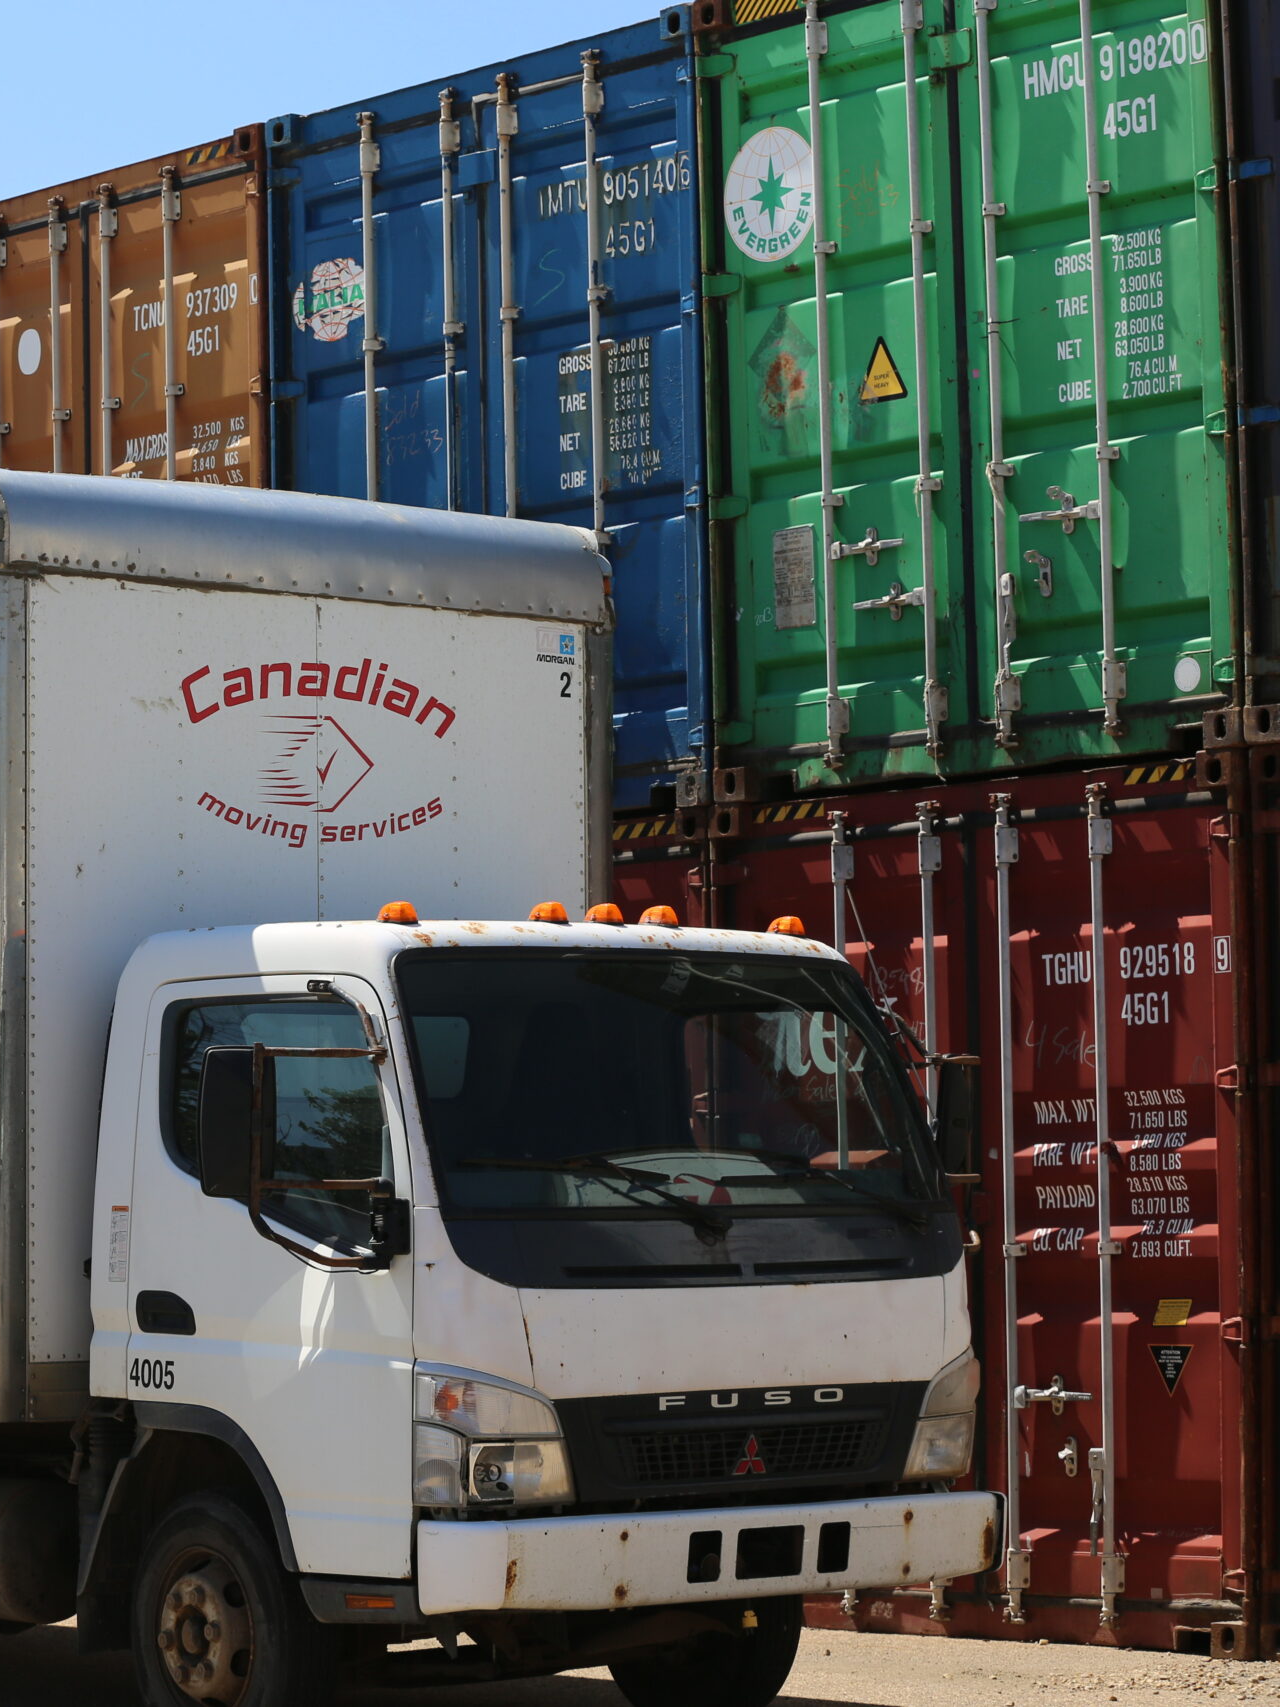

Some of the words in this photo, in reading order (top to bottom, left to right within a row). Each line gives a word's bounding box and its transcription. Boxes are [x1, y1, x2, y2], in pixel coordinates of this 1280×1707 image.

[1023, 52, 1085, 100] HMCU
[1103, 94, 1157, 140] 45G1
[732, 192, 812, 254] EVERGREEN
[605, 218, 655, 258] 45G1
[1111, 232, 1147, 252] 32.500
[1148, 228, 1161, 246] KG
[1055, 252, 1093, 276] GROSS
[1112, 250, 1147, 272] 71.650
[1148, 248, 1162, 265] LB
[1120, 273, 1149, 294] 3.900
[1149, 271, 1163, 289] KG
[133, 300, 165, 332] TCNU
[186, 282, 238, 318] 937309
[1056, 295, 1089, 318] TARE
[1120, 293, 1149, 313] 8.600
[1150, 290, 1163, 309] LB
[1114, 316, 1149, 338] 28.600
[1151, 314, 1164, 332] KG
[187, 324, 219, 357] 45G1
[1057, 338, 1082, 361] NET
[1115, 336, 1150, 357] 63.050
[1151, 333, 1164, 351] LB
[558, 354, 592, 375] GROSS
[1128, 359, 1150, 379] 76.4
[1152, 354, 1177, 374] CU.M
[1058, 379, 1092, 402] CUBE
[1122, 379, 1151, 400] 2.700
[1152, 374, 1182, 394] CU.FT
[559, 393, 587, 414] TARE
[193, 421, 221, 439] 32.500
[230, 416, 245, 432] KGS
[226, 434, 242, 448] LBS
[559, 432, 581, 452] NET
[193, 456, 216, 473] 3.840
[224, 451, 239, 467] KGS
[227, 469, 244, 484] LBS
[536, 654, 575, 665] MORGAN
[560, 672, 572, 698] 2
[180, 658, 456, 739] Canadian
[197, 791, 308, 848] moving
[320, 796, 443, 843] services
[1042, 950, 1092, 986] TGHU
[1119, 942, 1196, 980] 929518
[1217, 938, 1229, 971] 9
[1121, 991, 1169, 1026] 45G1
[1124, 1091, 1162, 1107] 32.500
[1162, 1088, 1186, 1105] KGS
[1034, 1100, 1071, 1125] MAX.
[1129, 1111, 1165, 1129] 71.650
[1168, 1110, 1188, 1127] LBS
[1164, 1132, 1186, 1148] KGS
[1033, 1142, 1065, 1166] TARE
[1071, 1142, 1096, 1166] WT.
[1130, 1155, 1158, 1172] 8.580
[1162, 1153, 1182, 1170] LBS
[1127, 1176, 1163, 1193] 28.610
[1164, 1175, 1188, 1191] KGS
[1036, 1184, 1095, 1209] PAYLOAD
[1131, 1198, 1167, 1215] 63.070
[1170, 1197, 1190, 1213] LBS
[1033, 1228, 1051, 1252] CU.
[1056, 1227, 1085, 1251] CAP.
[1132, 1241, 1161, 1258] 2.693
[129, 1358, 175, 1390] 4005
[659, 1388, 844, 1411] FUSO
